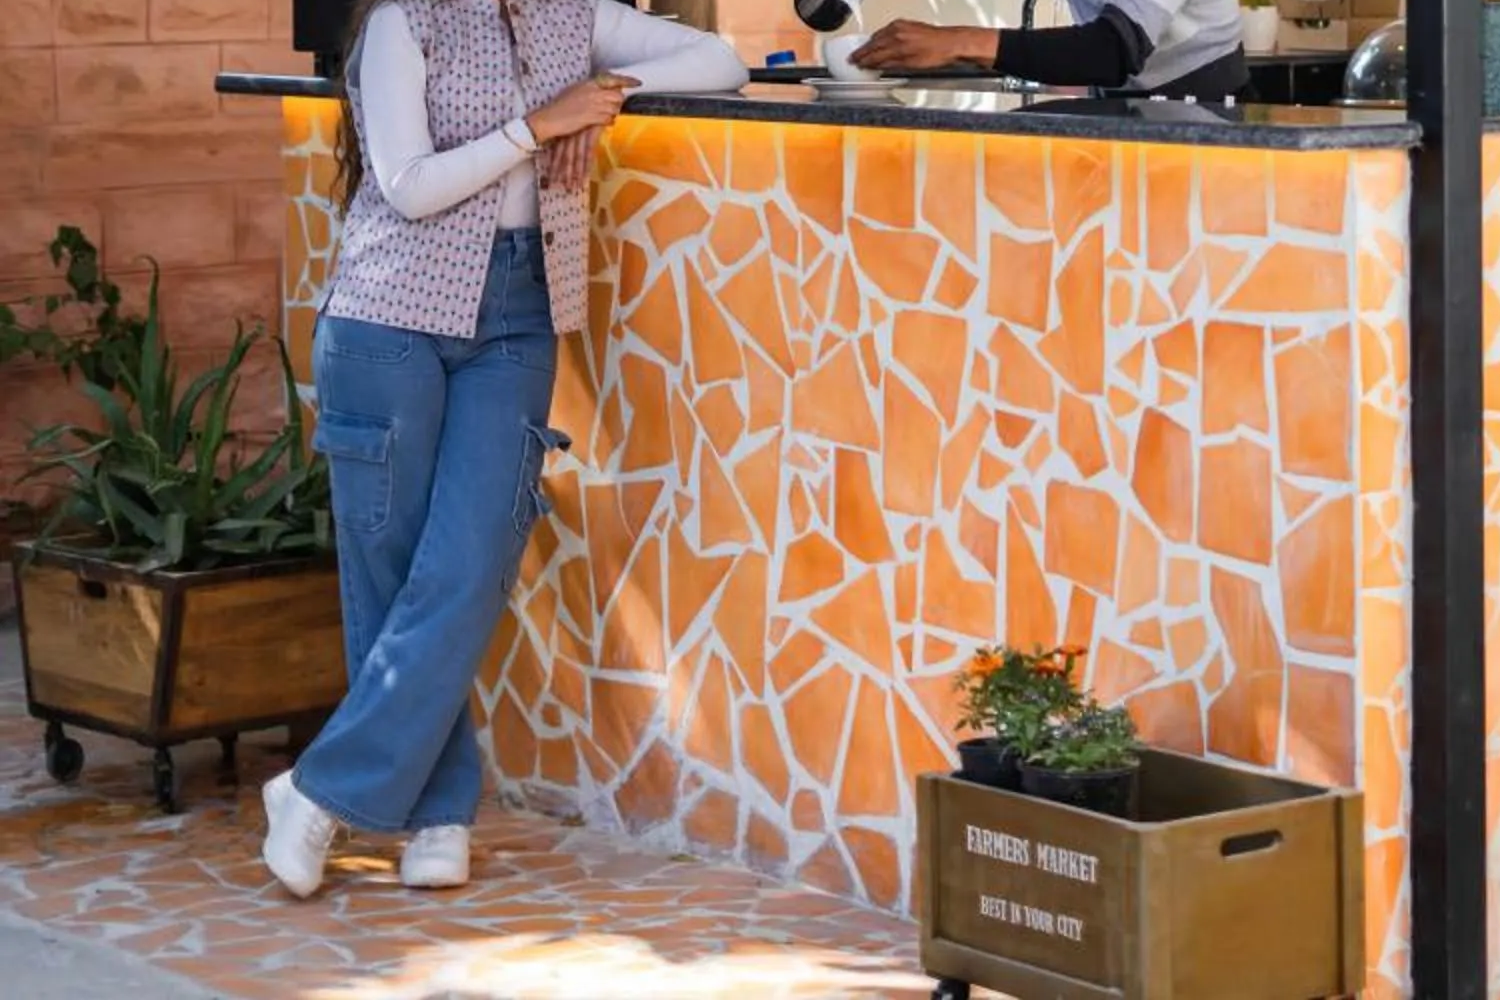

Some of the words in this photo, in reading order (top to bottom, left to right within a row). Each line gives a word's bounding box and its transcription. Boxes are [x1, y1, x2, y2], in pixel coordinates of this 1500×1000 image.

[966, 824, 1030, 866] FARMERS
[1037, 842, 1099, 884] MARKET
[980, 895, 1007, 922] BEST
[1010, 902, 1022, 924] IN
[1024, 905, 1053, 934] YOUR
[1057, 914, 1083, 942] CITY
